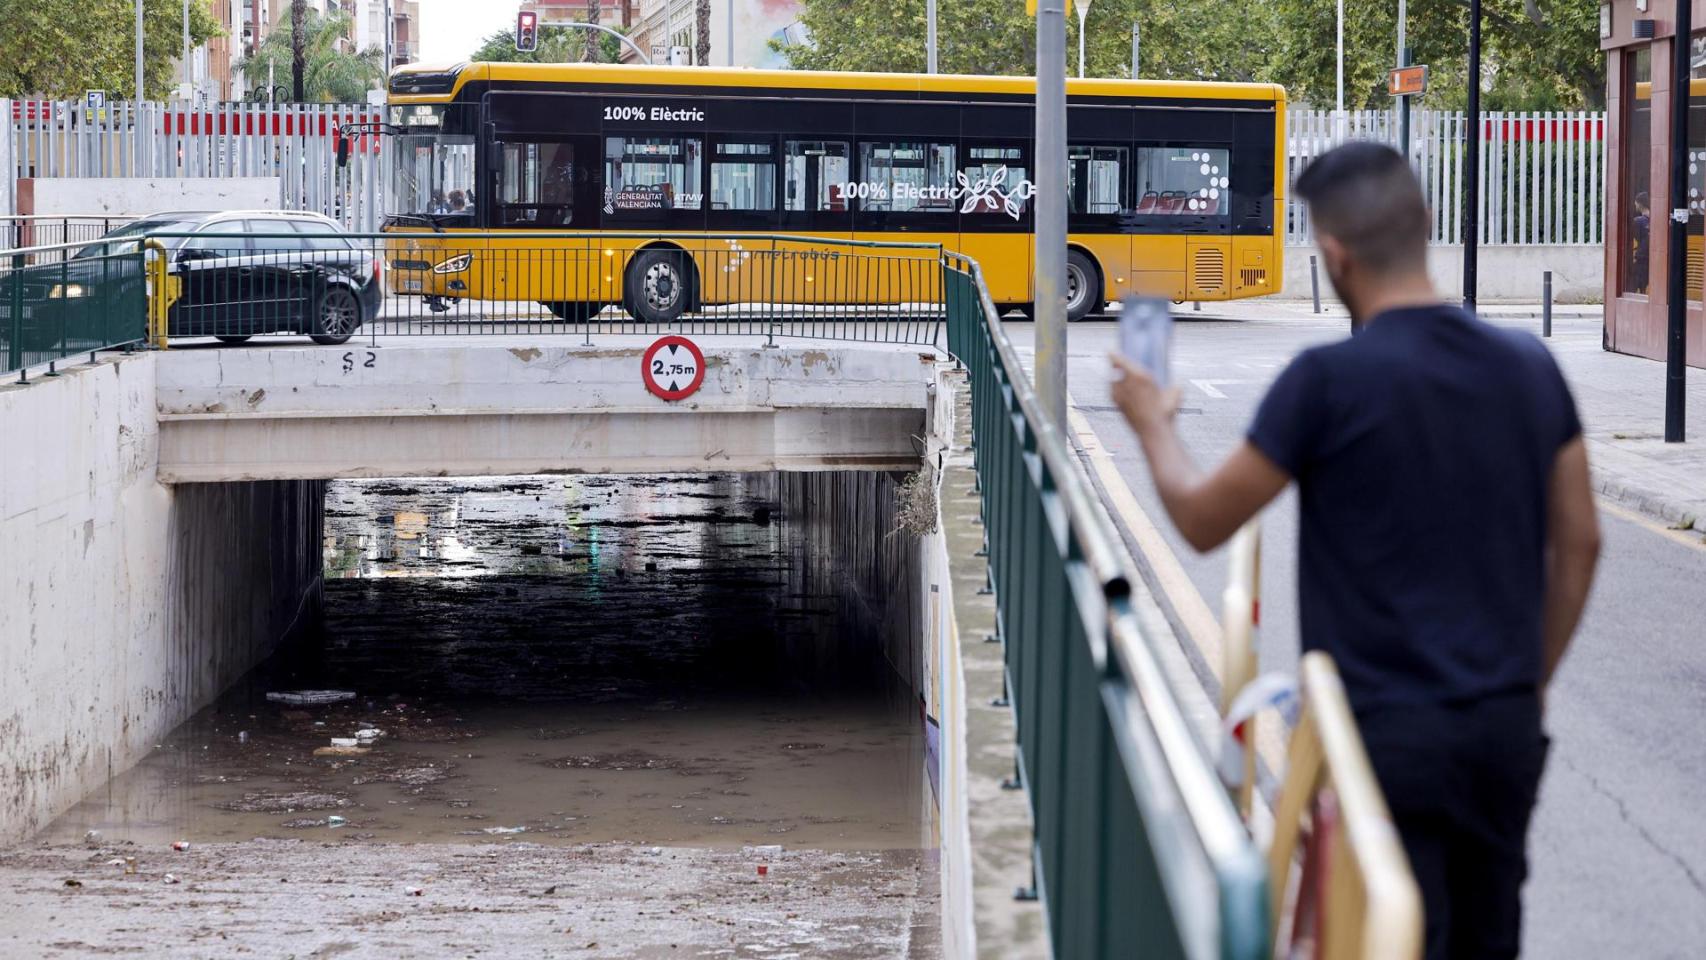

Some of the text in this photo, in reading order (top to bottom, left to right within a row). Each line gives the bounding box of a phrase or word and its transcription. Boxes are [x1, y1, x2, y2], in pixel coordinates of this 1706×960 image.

[604, 106, 705, 121] 100% Elèctric
[836, 181, 961, 199] 100% Elèctric
[616, 201, 662, 209] VALENCIANA
[363, 351, 376, 368] 2
